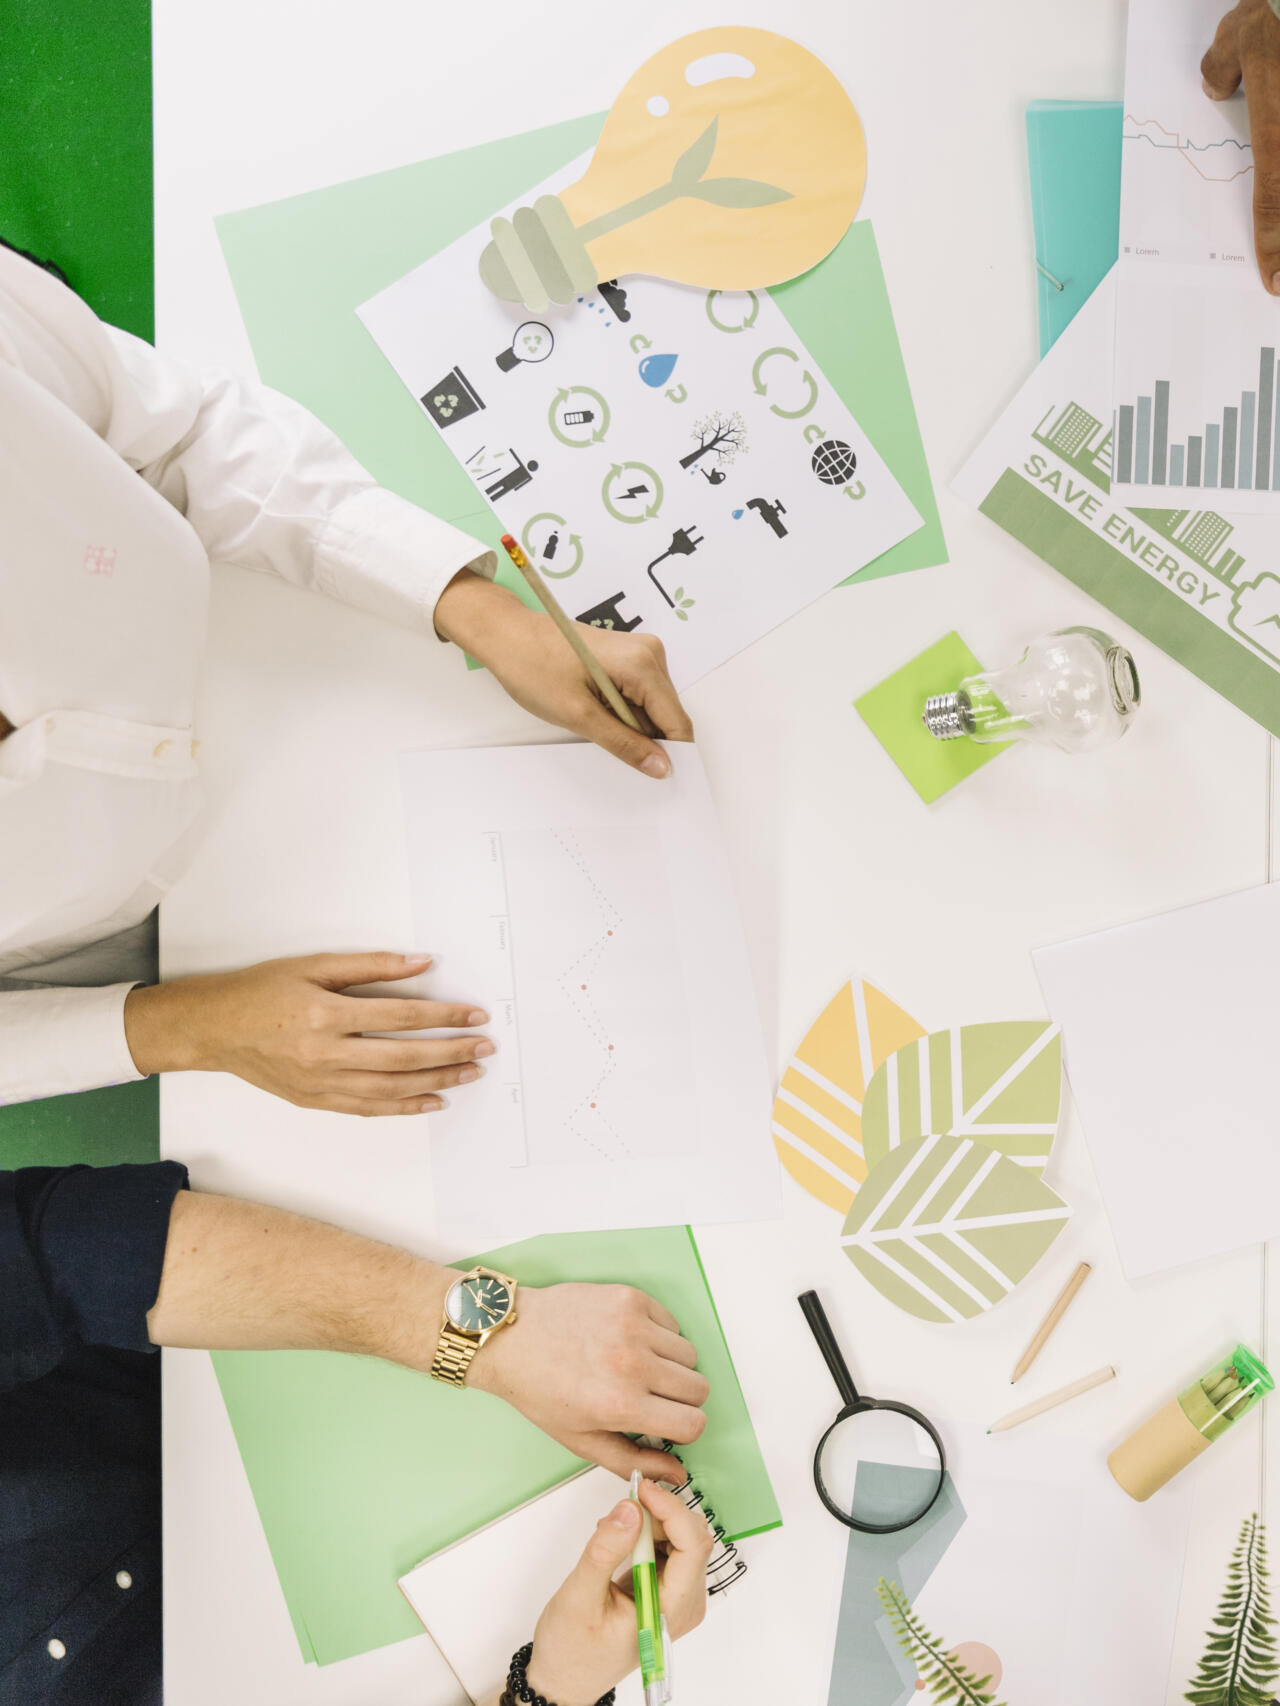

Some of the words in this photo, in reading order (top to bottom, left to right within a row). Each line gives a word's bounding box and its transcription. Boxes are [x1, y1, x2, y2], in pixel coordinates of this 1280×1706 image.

[1135, 247, 1160, 257] Lorem
[1222, 253, 1245, 263] Lorem
[1024, 454, 1104, 521] SAVE
[1101, 513, 1221, 606] ENERGY
